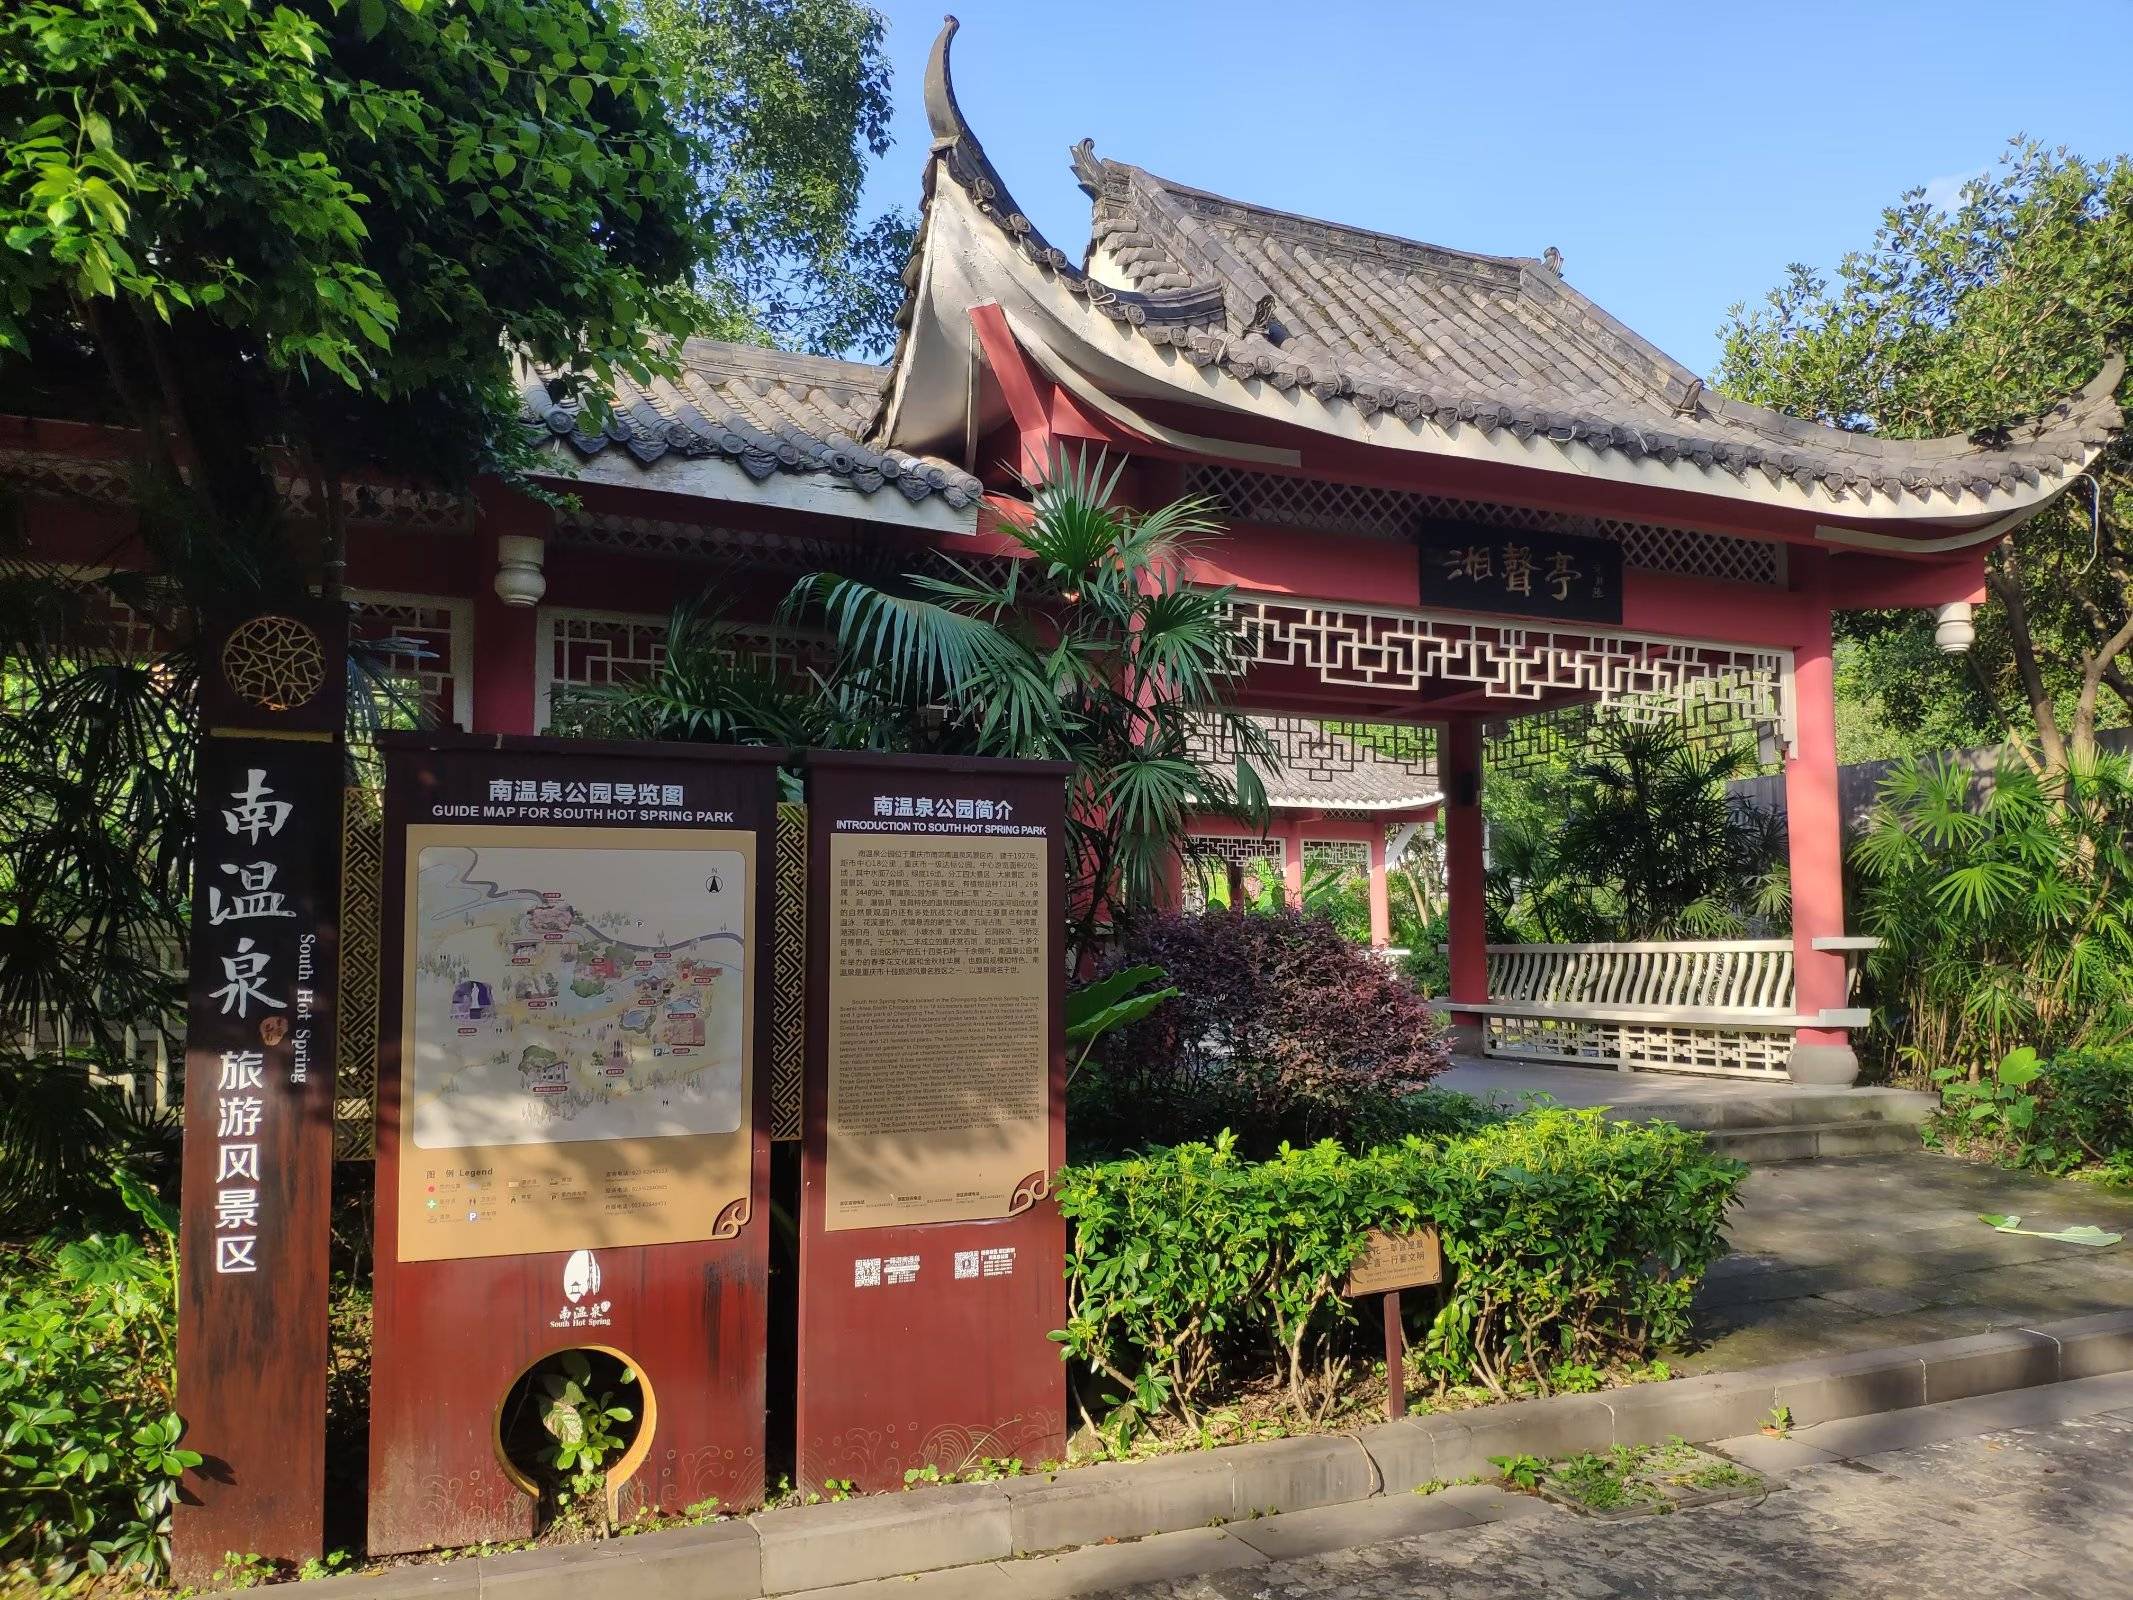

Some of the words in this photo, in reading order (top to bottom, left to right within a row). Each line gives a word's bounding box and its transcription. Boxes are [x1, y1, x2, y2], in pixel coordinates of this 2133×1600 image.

[488, 779, 684, 807] 南温泉公园导览图
[432, 804, 480, 818] GUIDE
[483, 806, 516, 818] MAP
[519, 807, 549, 819] FOR
[553, 807, 603, 820] SOUTH
[606, 809, 636, 821] HOT
[640, 810, 693, 822] SPRING
[696, 811, 734, 823] PARK
[873, 795, 1014, 821] 南温泉公园简介
[836, 819, 911, 832] INTRODUCTION
[913, 822, 927, 832] TO
[928, 822, 962, 833] SOUTH
[963, 823, 983, 834] HOT
[985, 824, 1020, 835] SPRING
[1021, 825, 1047, 836] PARK
[208, 768, 297, 1019] 南温泉
[297, 934, 316, 981] South
[296, 988, 313, 1020] Hot
[290, 1029, 312, 1084] Spring
[214, 1050, 264, 1274] 旅游风景区
[459, 1167, 493, 1178] Legend
[549, 1320, 570, 1328] South
[572, 1319, 586, 1327] Hot
[588, 1318, 611, 1327] Spring
[559, 1303, 604, 1321] 南温泉
